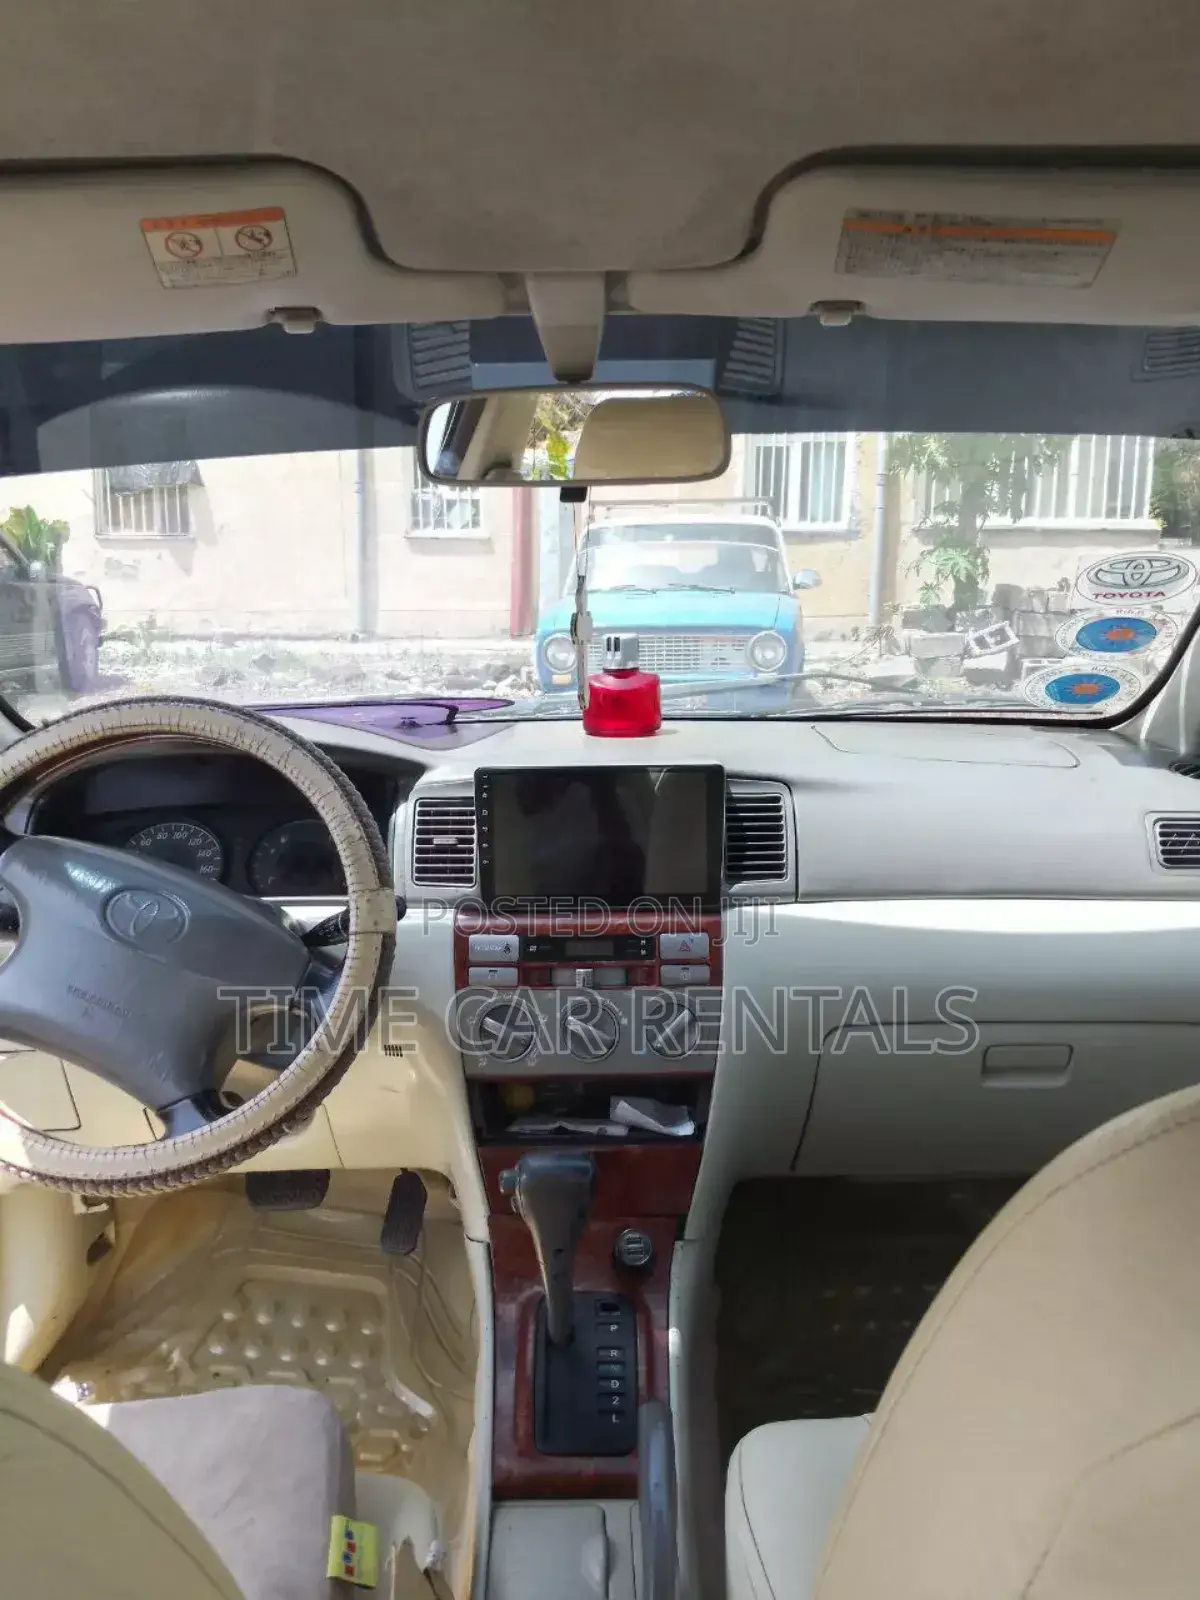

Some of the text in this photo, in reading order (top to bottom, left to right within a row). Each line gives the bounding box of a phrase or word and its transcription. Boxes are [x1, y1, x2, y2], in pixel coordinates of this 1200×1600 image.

[1092, 590, 1167, 600] TOYOTA
[172, 831, 188, 840] 100
[188, 837, 202, 846] 120
[200, 864, 214, 874] 160
[610, 1324, 619, 1332] P
[610, 1349, 619, 1357] R
[610, 1379, 620, 1389] D
[612, 1396, 620, 1405] 2
[611, 1413, 620, 1423] L
